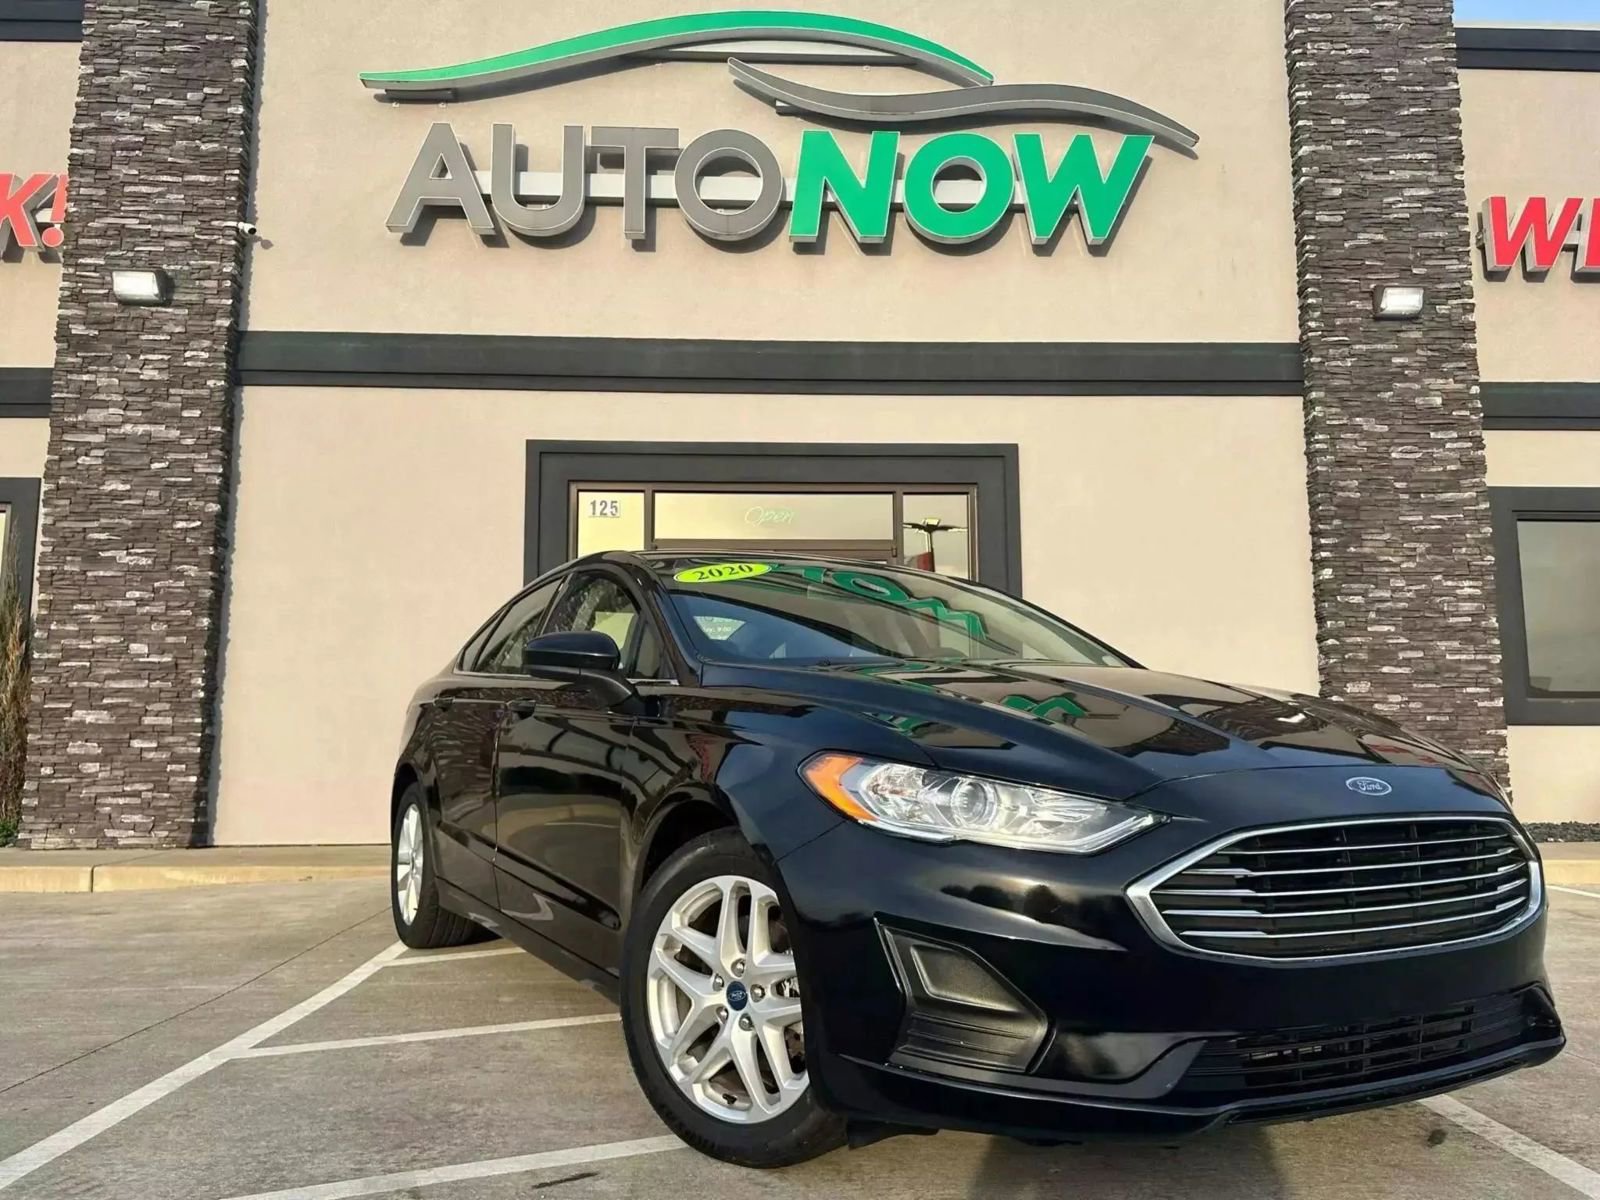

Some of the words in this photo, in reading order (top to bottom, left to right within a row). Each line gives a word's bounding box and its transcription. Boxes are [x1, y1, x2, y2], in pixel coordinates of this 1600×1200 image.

[1487, 194, 1600, 268] W
[590, 500, 619, 516] 125
[744, 506, 794, 527] Open
[697, 563, 754, 581] 2020
